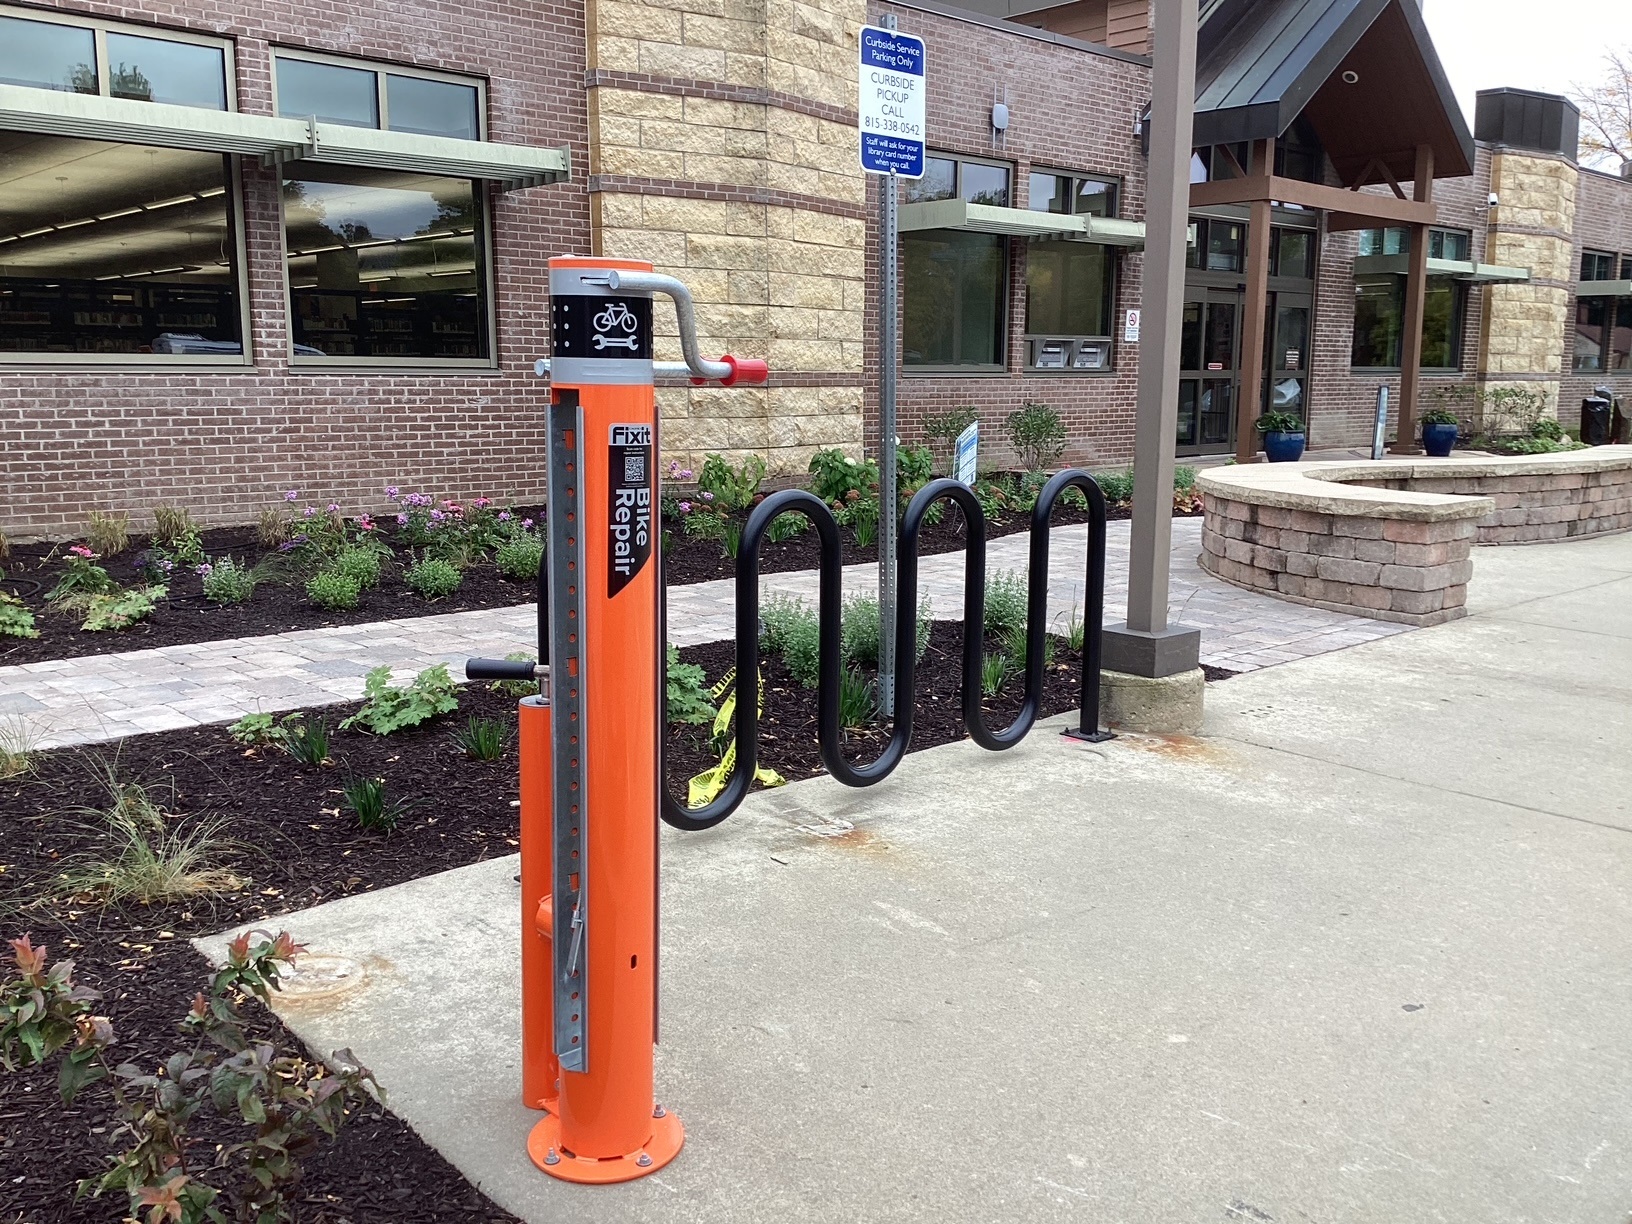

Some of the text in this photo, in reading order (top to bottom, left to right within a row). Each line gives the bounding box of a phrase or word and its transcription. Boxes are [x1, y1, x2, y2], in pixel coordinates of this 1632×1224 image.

[865, 35, 920, 57] Curbside Service
[871, 49, 914, 69] Parking Only
[870, 71, 915, 91] CURBSIDE
[876, 87, 909, 104] PICKUP
[881, 103, 905, 119] CALL
[864, 115, 920, 136] 815-338-0542
[865, 136, 919, 153] Staff will ask for your
[867, 146, 917, 162] library card number
[874, 158, 890, 167] when
[889, 161, 900, 169] you
[612, 426, 651, 445] Fixit
[635, 487, 650, 547] Bike
[610, 488, 636, 576] Repair
